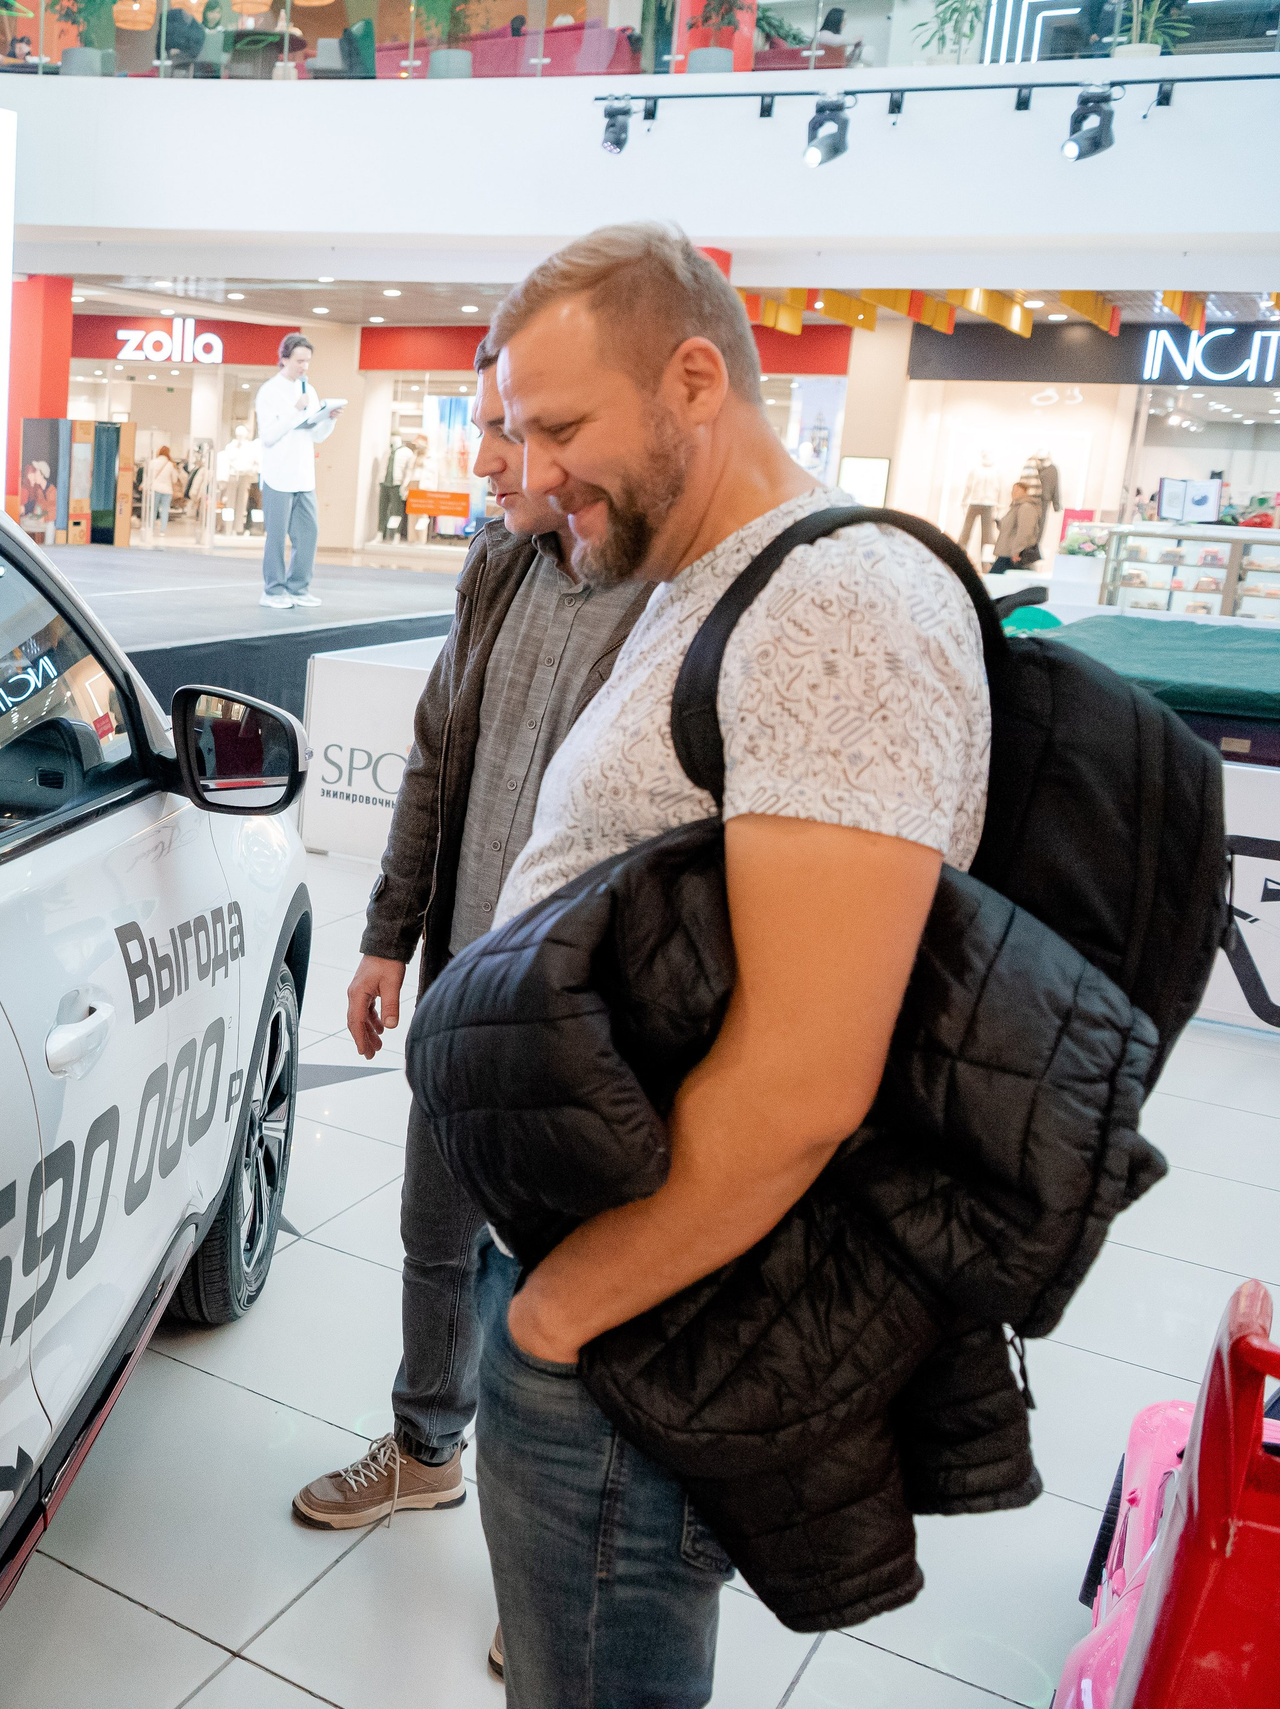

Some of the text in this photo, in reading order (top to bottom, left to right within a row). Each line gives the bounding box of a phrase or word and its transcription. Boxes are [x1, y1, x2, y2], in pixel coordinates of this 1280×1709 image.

[116, 316, 224, 364] zolla
[114, 900, 246, 1025] Выгода
[124, 1016, 225, 1217] 000
